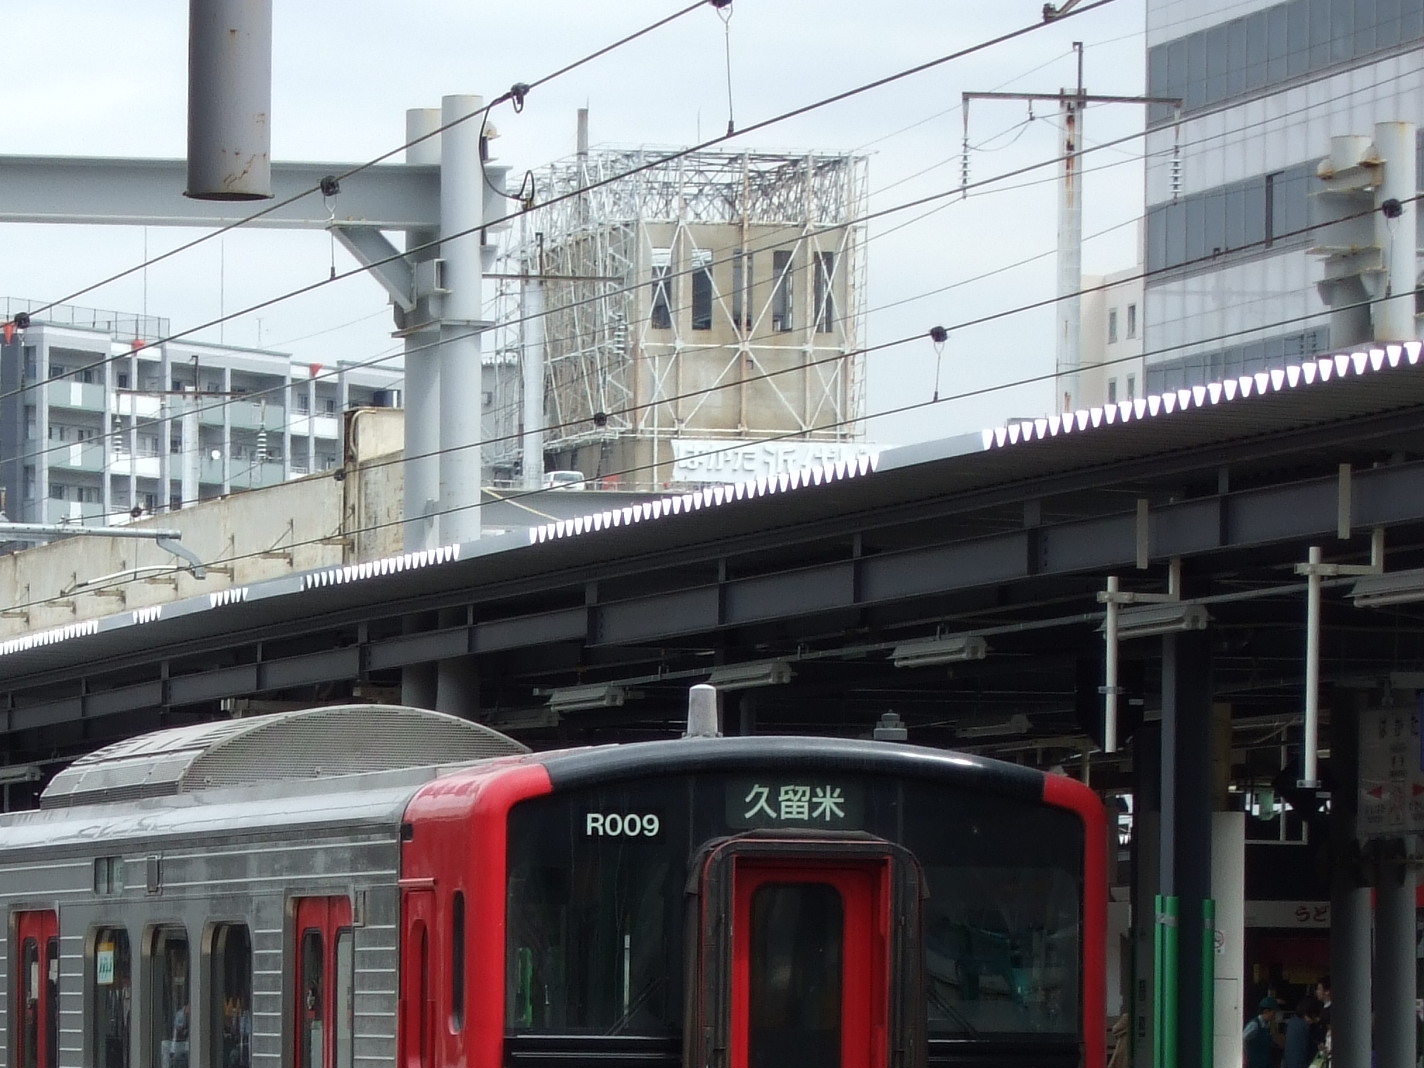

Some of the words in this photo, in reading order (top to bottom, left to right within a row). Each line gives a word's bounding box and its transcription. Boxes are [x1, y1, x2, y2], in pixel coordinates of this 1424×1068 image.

[744, 784, 845, 821] 久留米
[586, 813, 660, 836] R009
